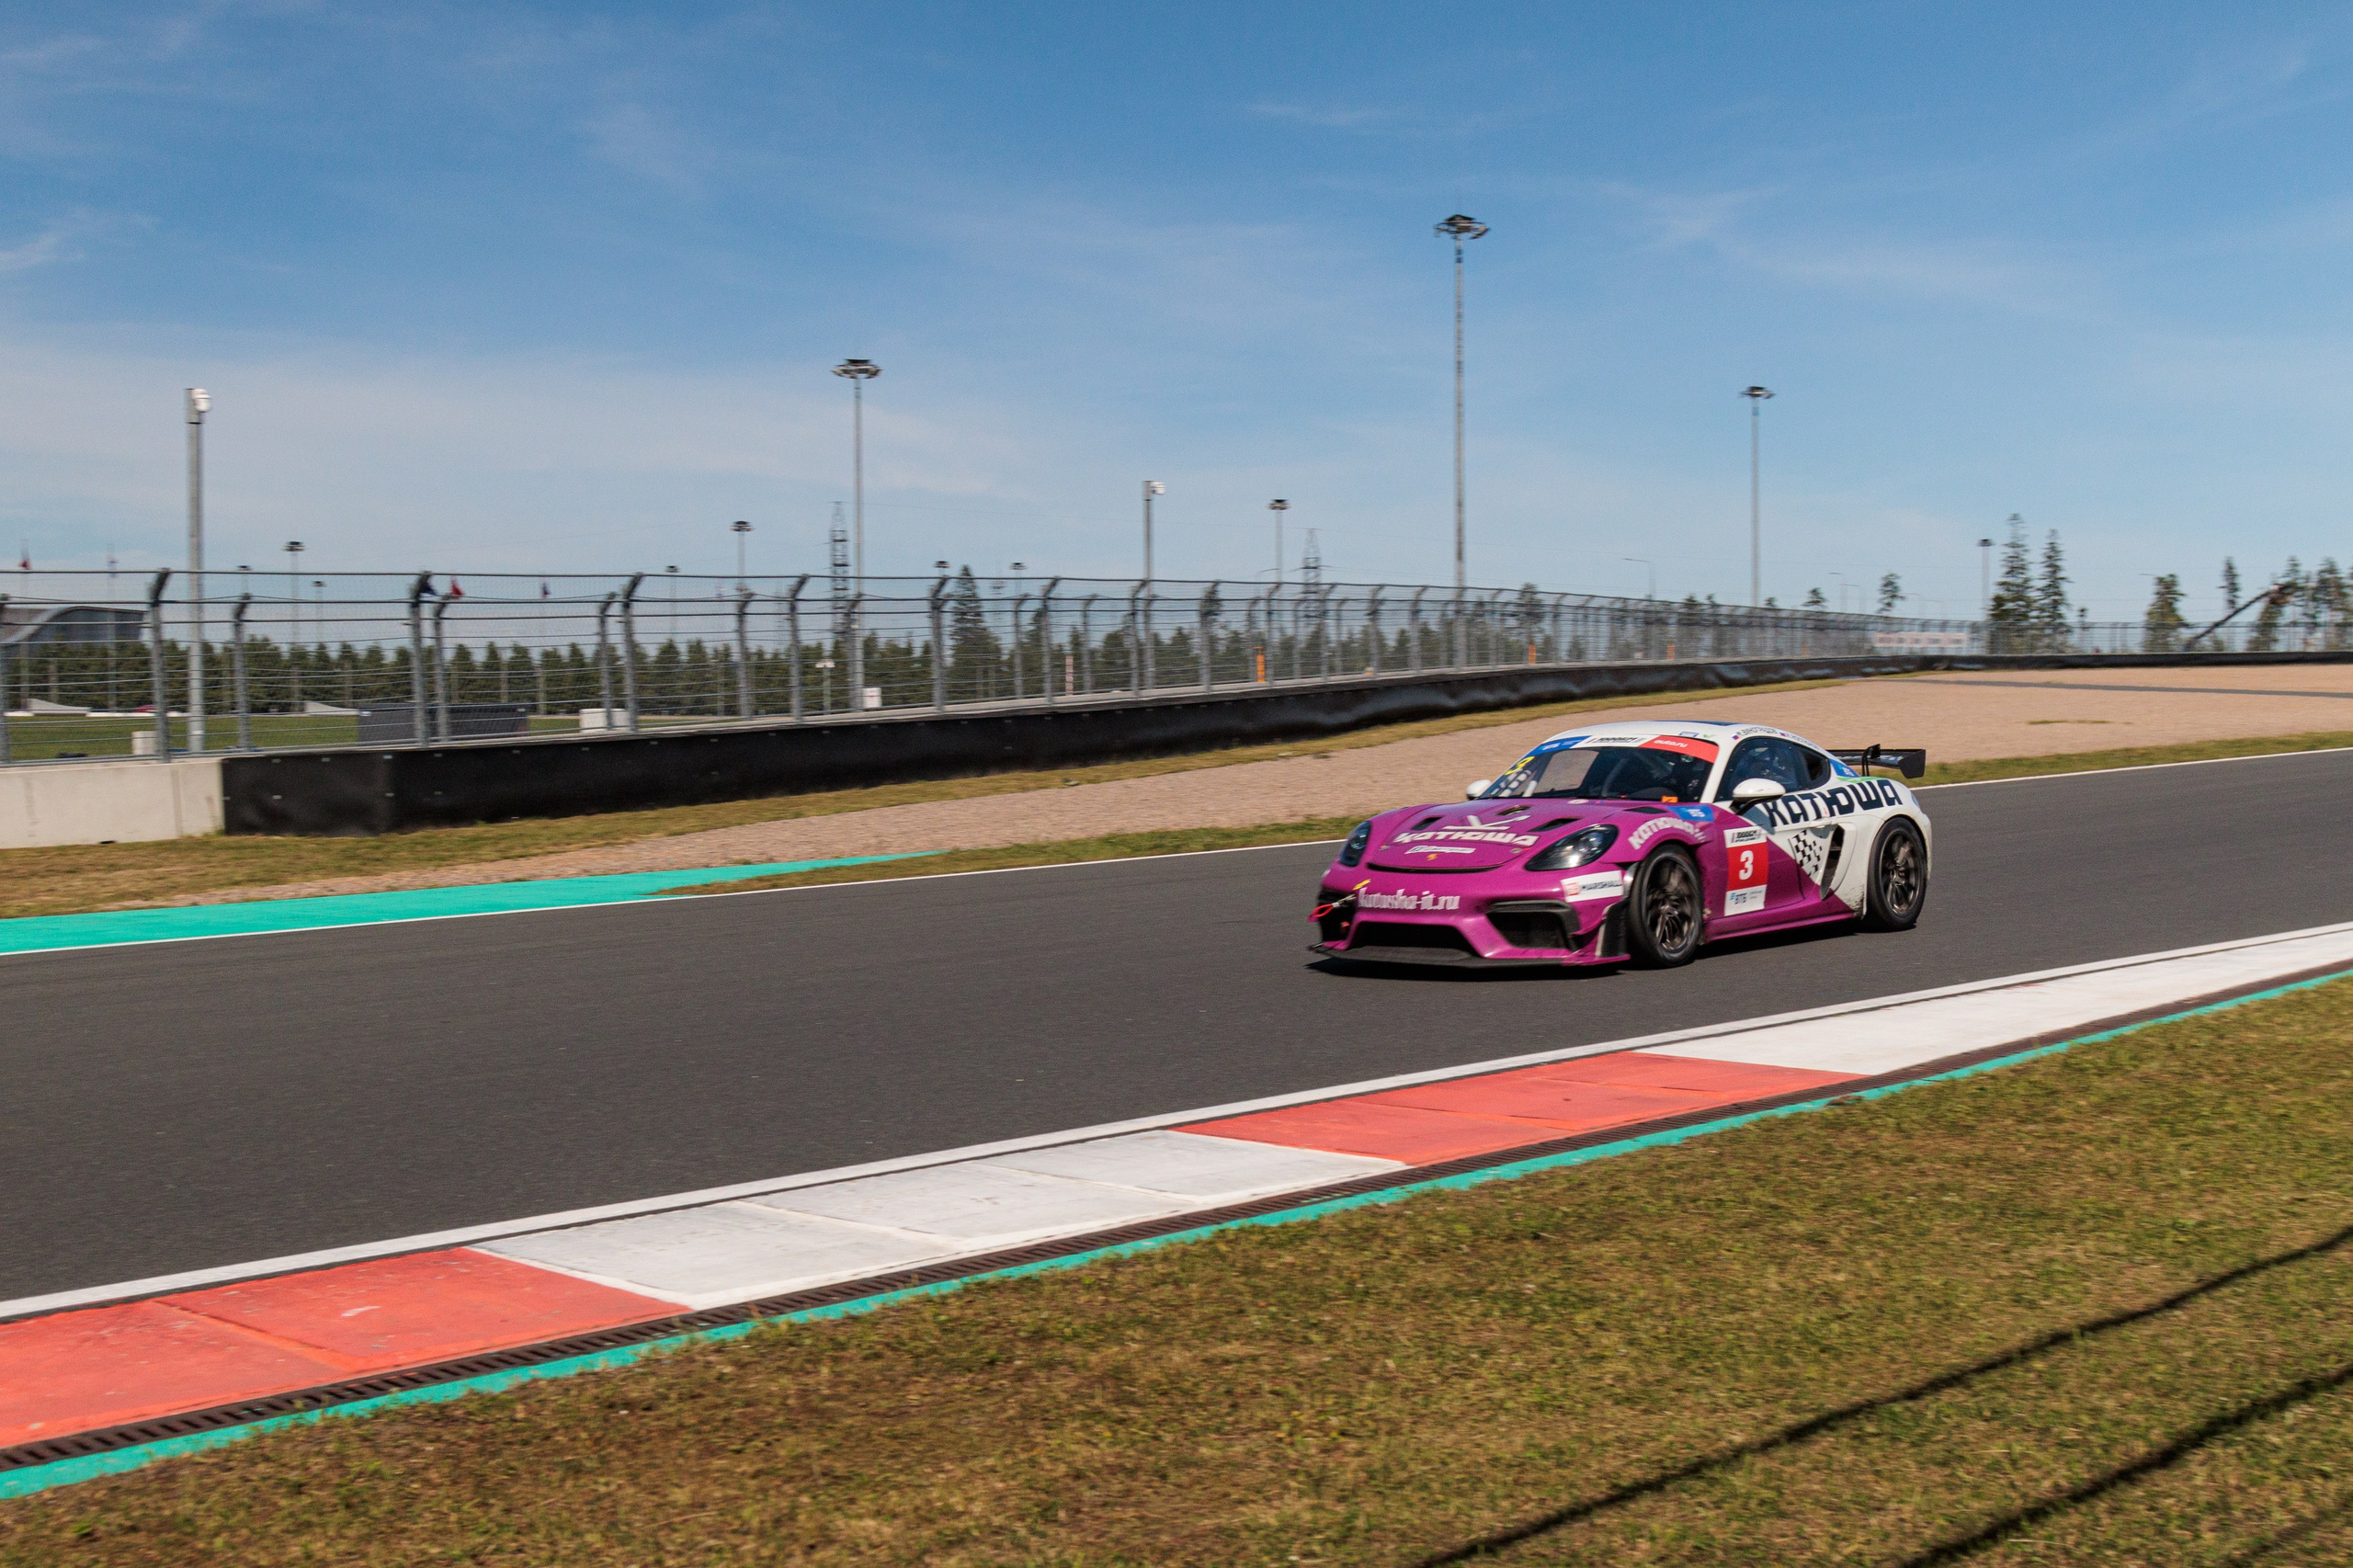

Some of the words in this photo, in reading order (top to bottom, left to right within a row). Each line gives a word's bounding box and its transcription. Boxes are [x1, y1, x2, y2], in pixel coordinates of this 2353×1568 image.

[1653, 739, 1689, 748] auto.ru
[1505, 756, 1535, 776] 3
[1762, 779, 1904, 828] КАТЮША
[1393, 831, 1540, 846] КАТЮША
[1738, 850, 1754, 881] 3
